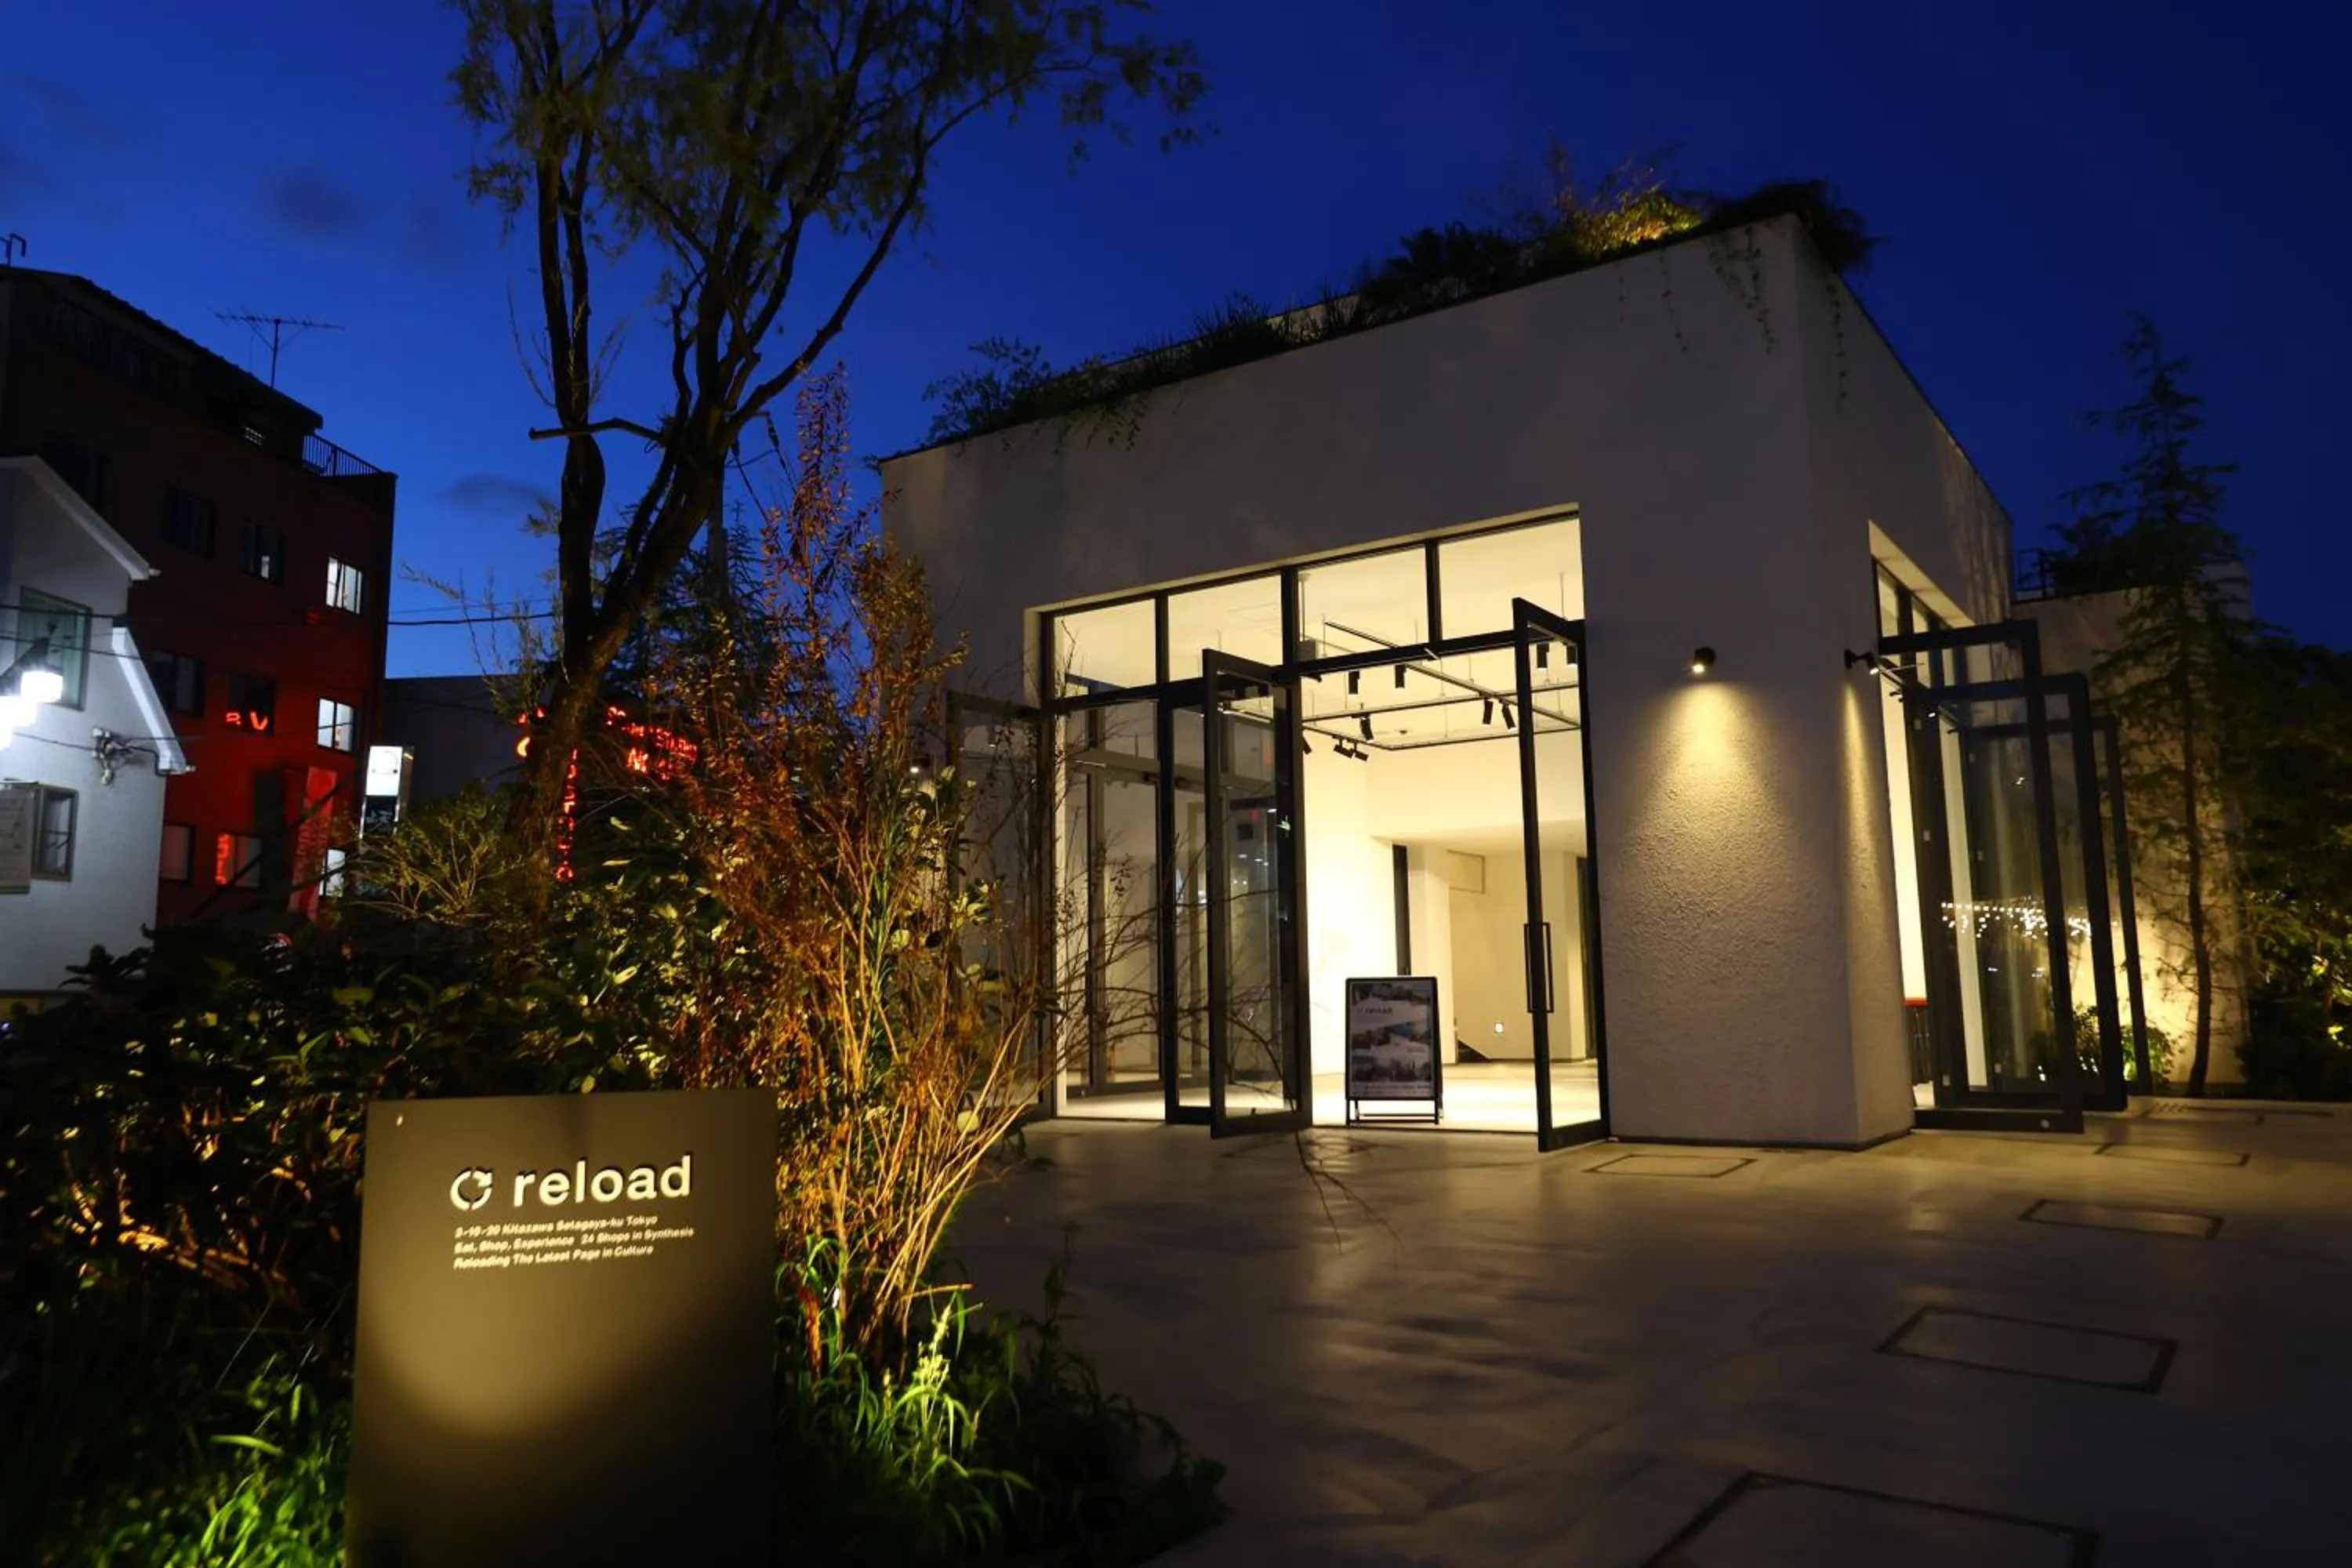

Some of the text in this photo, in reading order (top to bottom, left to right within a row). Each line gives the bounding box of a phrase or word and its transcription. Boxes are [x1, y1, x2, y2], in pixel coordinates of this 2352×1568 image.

[514, 1155, 691, 1207] reload
[626, 1215, 658, 1227] Tokyo
[514, 1236, 575, 1250] Experience
[632, 1231, 643, 1241] in
[644, 1227, 695, 1241] Synthesis
[512, 1253, 534, 1265] The
[572, 1248, 601, 1261] Page
[601, 1248, 614, 1258] in
[614, 1245, 655, 1257] Culture
